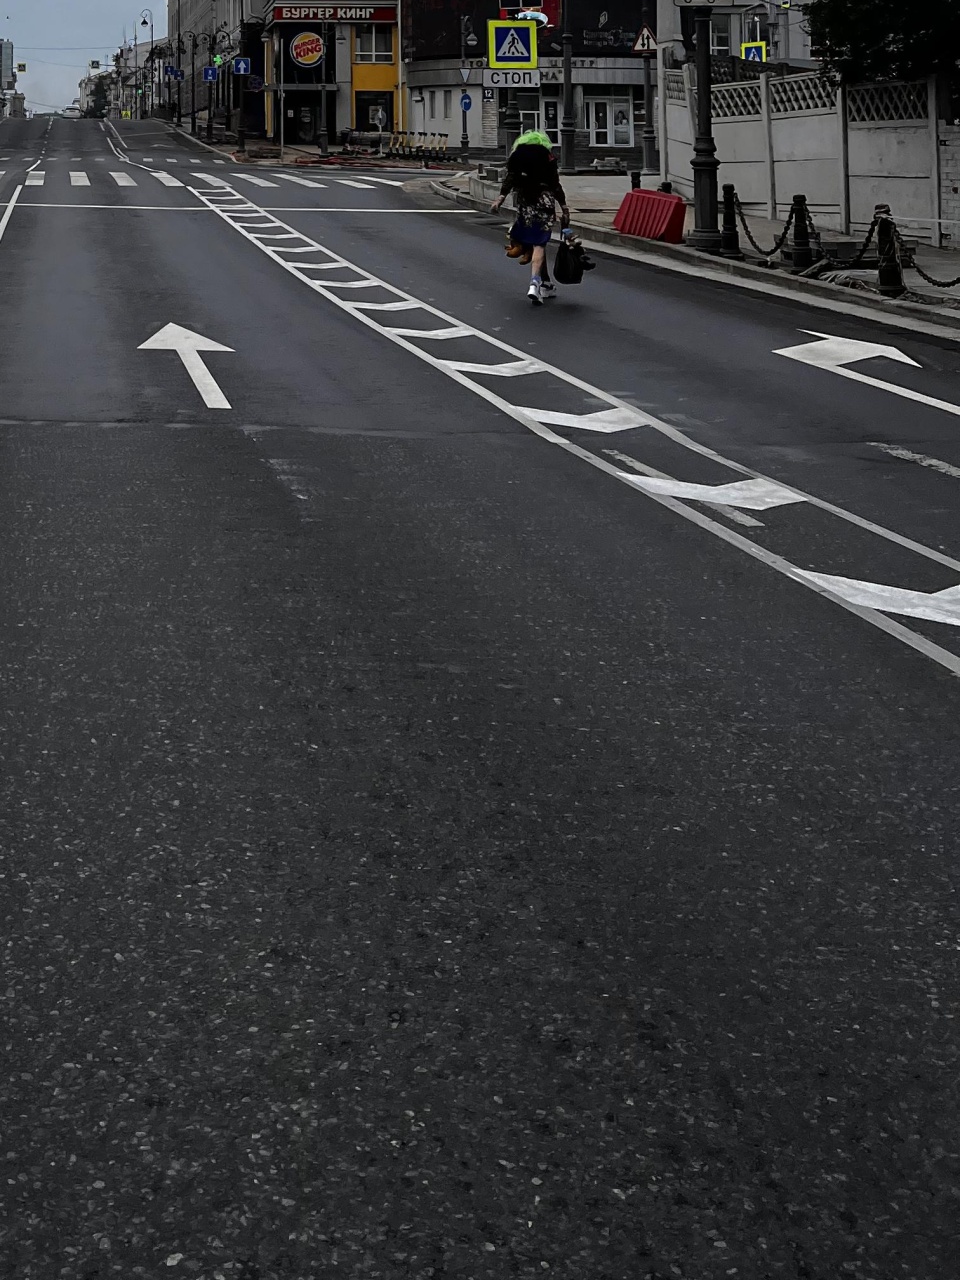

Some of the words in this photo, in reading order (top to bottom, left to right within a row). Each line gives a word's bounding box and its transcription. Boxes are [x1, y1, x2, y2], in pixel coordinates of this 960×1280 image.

[282, 7, 334, 19] БУРГЕР
[336, 8, 374, 19] КИНГ
[294, 38, 321, 51] BURGER
[295, 44, 322, 60] KING
[491, 72, 531, 84] СТОП
[484, 89, 493, 98] 12
